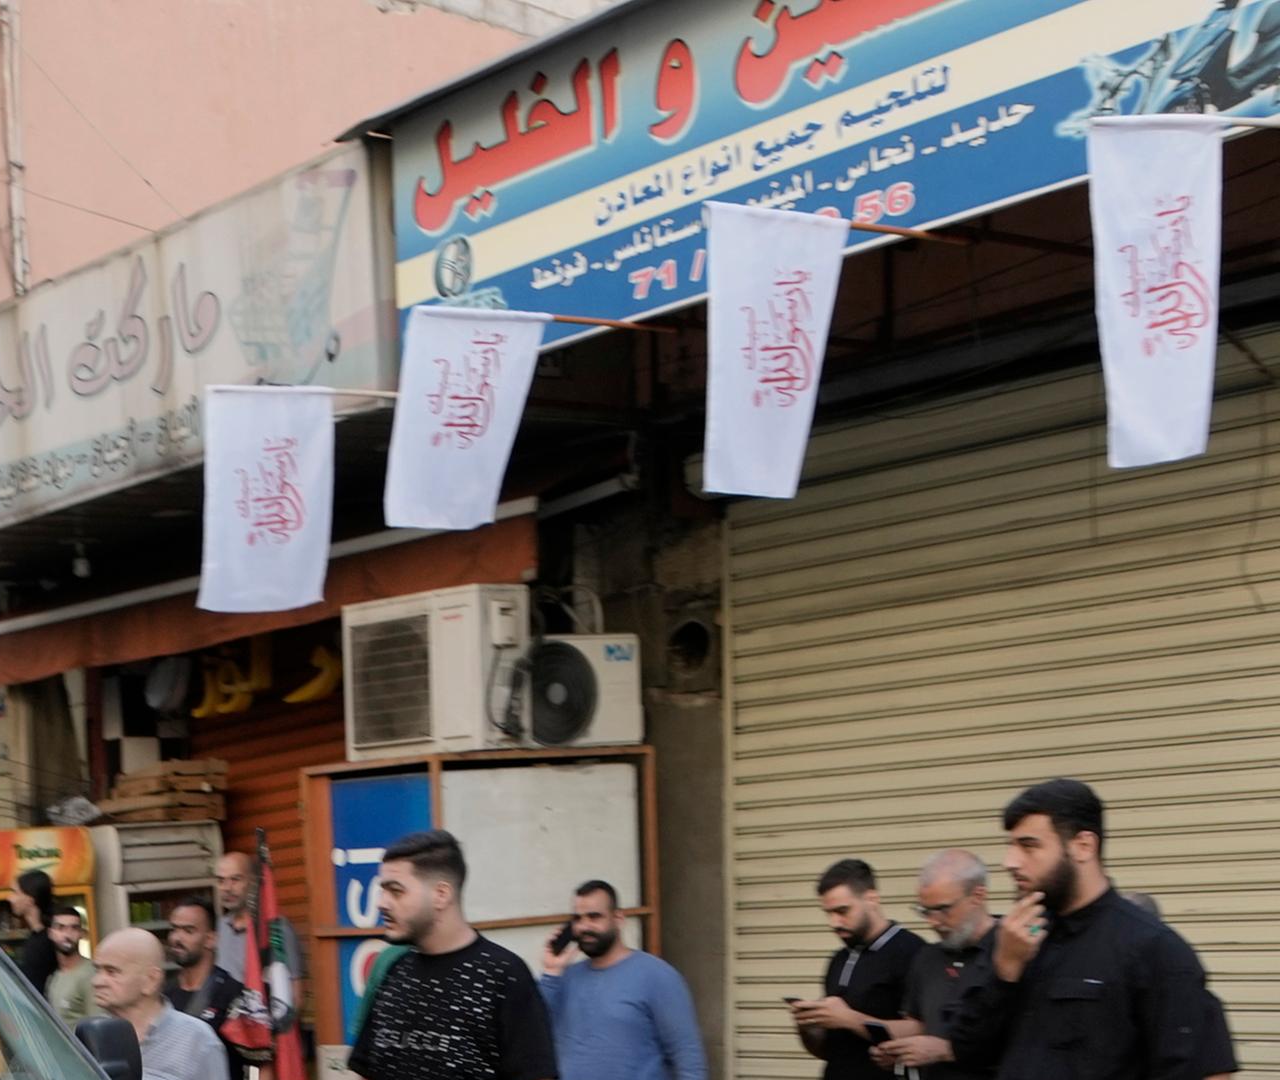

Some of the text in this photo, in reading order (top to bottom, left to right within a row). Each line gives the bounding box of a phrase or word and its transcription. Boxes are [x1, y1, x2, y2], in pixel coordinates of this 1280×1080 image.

[649, 38, 696, 142] و
[414, 47, 618, 233] الخليل
[753, 120, 823, 172] جميع
[941, 100, 1036, 147] حديد
[836, 135, 916, 192] نحاس
[595, 168, 672, 227] المعادن
